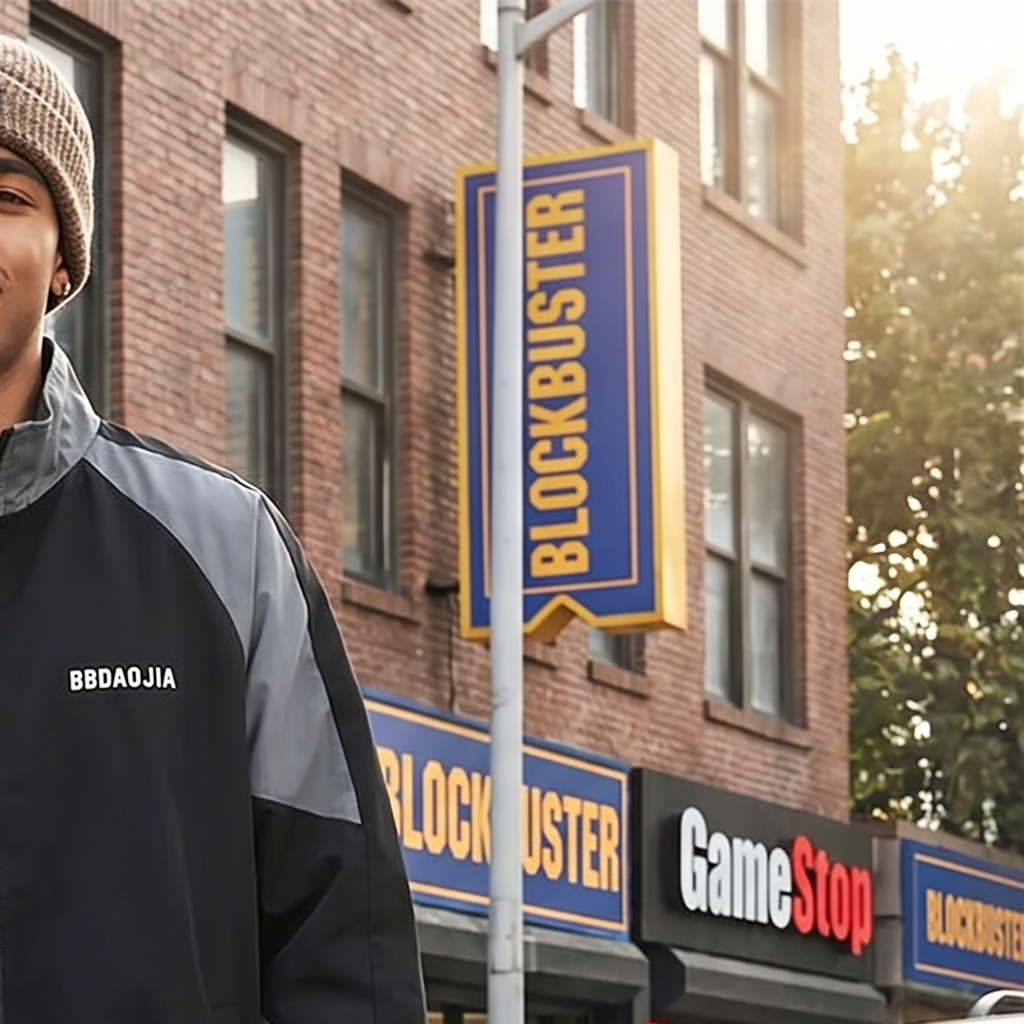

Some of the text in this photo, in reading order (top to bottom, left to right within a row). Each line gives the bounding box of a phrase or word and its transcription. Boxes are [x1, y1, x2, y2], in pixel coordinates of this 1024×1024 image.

[525, 188, 590, 579] BLOCKBUSTER
[69, 666, 177, 691] BBDAOJIA
[375, 745, 620, 892] BLOCKUSTER
[680, 806, 872, 957] GameStop
[925, 888, 1024, 964] BLOCKBUSTE
